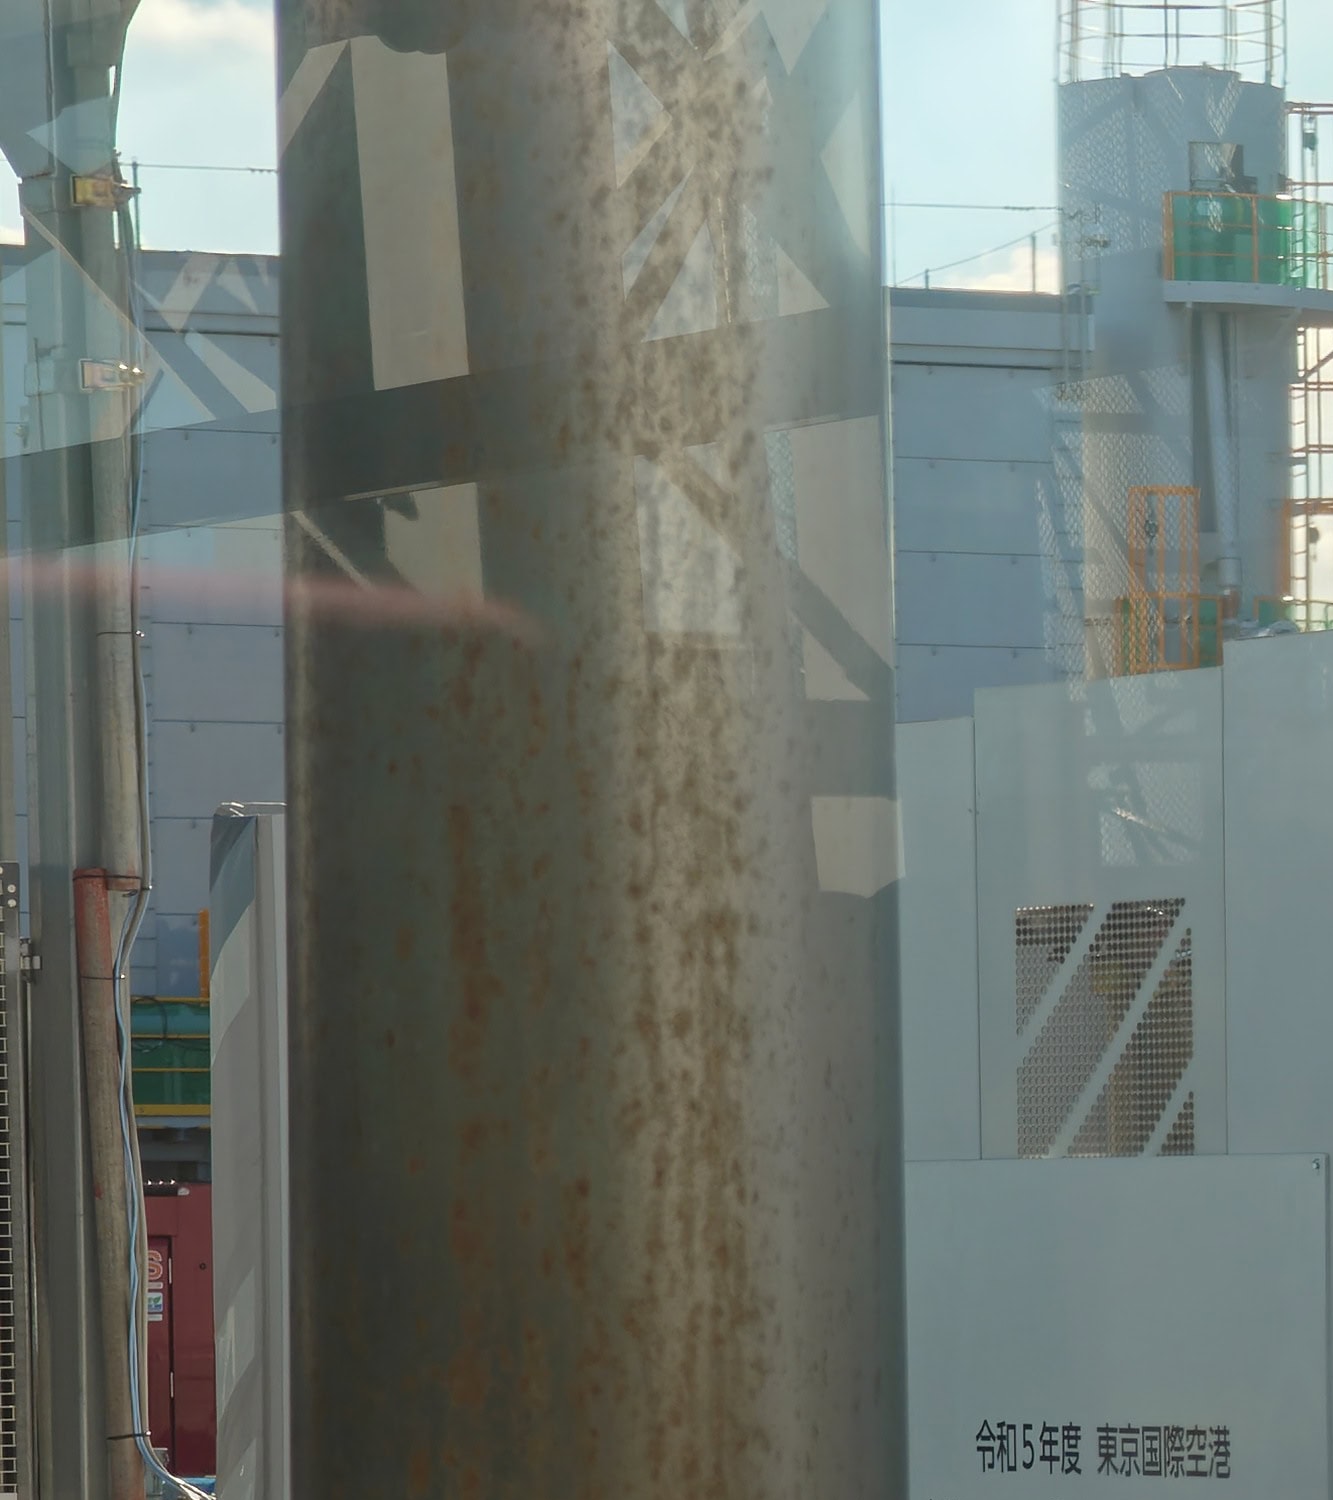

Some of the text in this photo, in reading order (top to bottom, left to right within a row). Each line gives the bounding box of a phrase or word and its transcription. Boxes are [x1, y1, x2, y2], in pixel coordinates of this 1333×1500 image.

[975, 1419, 1230, 1479] 令和5年度 東京国際空港
